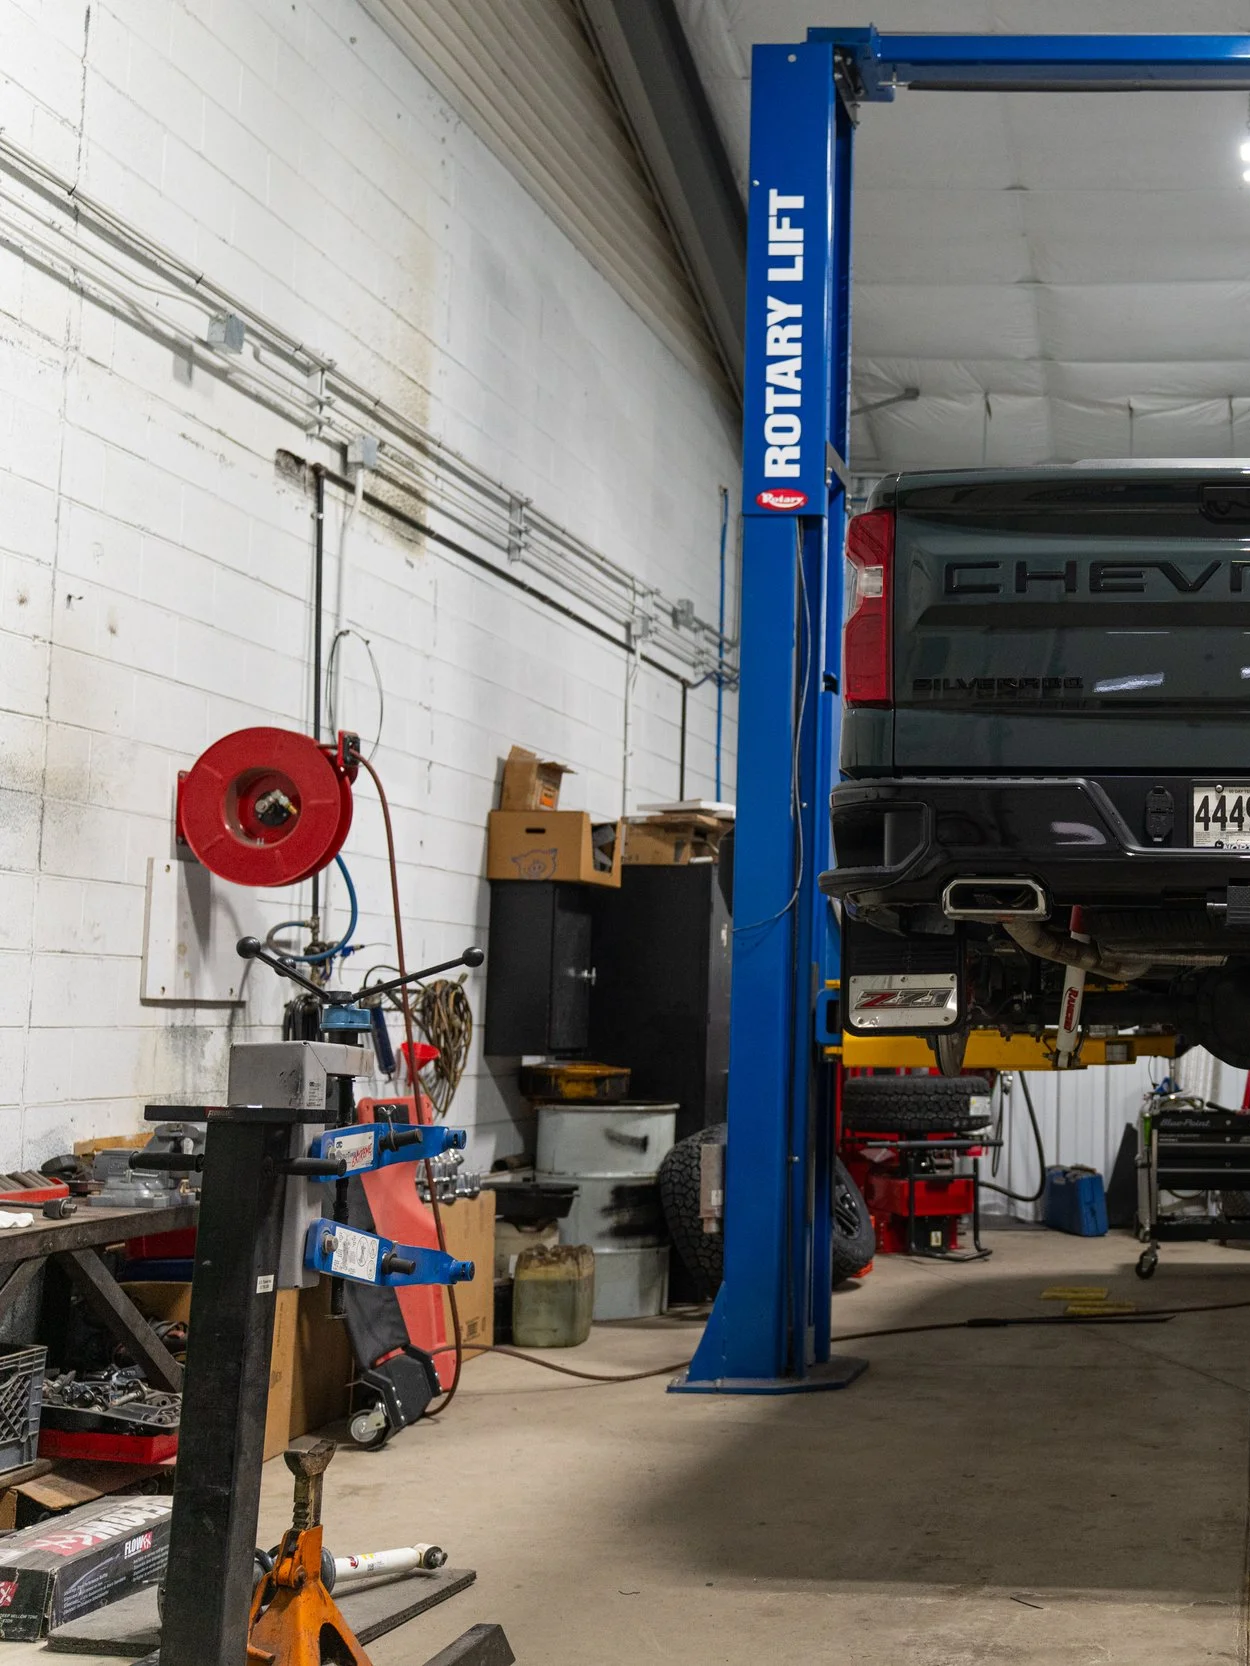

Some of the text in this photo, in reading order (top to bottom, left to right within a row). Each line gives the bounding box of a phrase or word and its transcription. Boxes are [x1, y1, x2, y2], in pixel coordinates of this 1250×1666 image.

[764, 188, 804, 478] ROTARY LIFT
[761, 492, 804, 508] Rotary
[855, 988, 953, 1009] Z71
